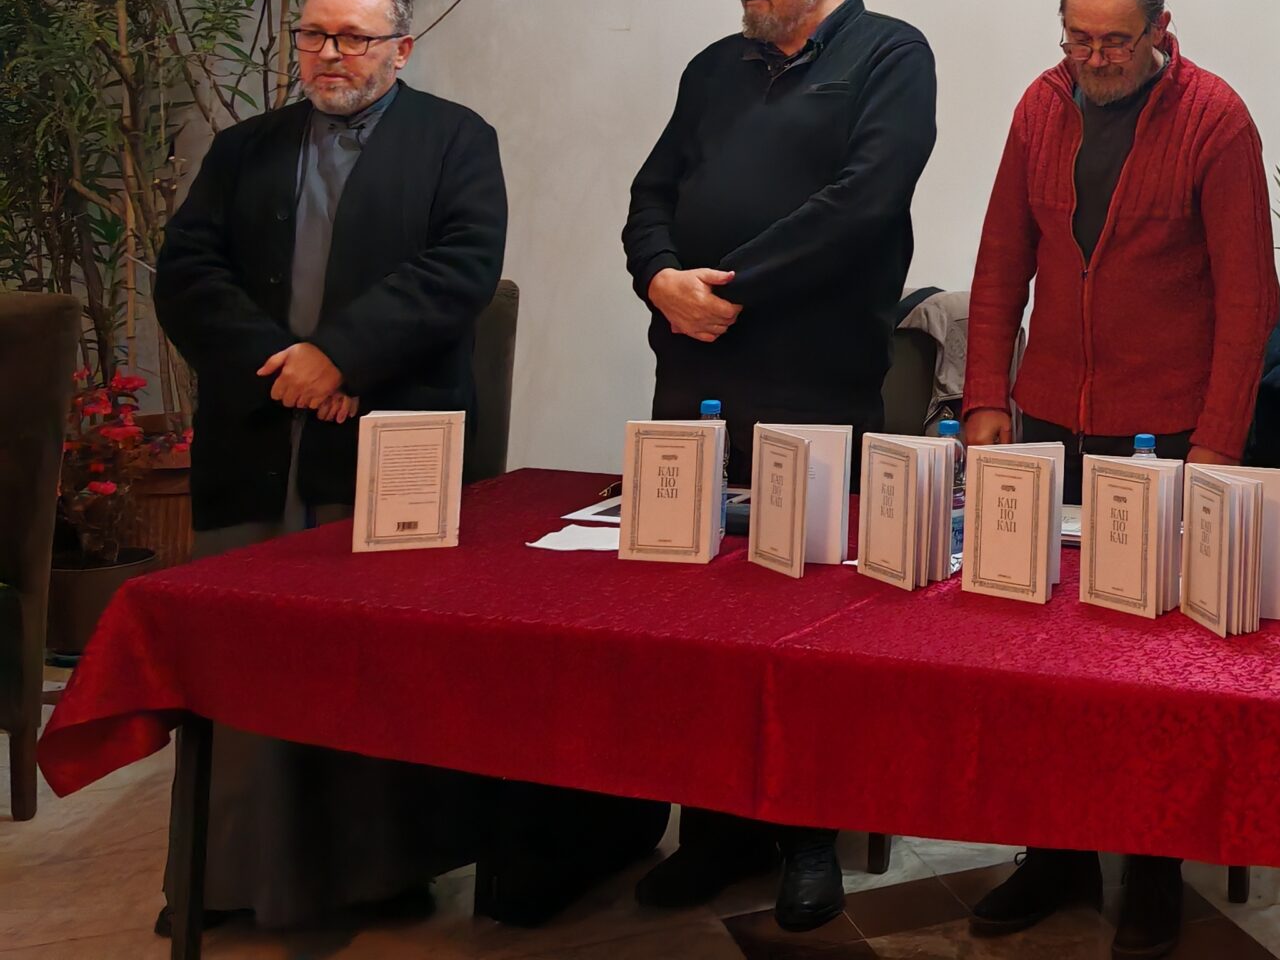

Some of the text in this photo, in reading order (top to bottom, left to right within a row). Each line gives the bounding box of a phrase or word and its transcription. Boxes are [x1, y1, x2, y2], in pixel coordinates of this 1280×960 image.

[658, 466, 679, 477] КАП
[661, 477, 676, 488] ПО
[657, 488, 678, 499] КАП
[997, 497, 1017, 510] КАП
[1000, 509, 1014, 521] ПО
[1110, 508, 1129, 521] КАП
[996, 520, 1017, 533] КАП
[1113, 520, 1126, 532] ПО
[1110, 531, 1128, 545] КАП
